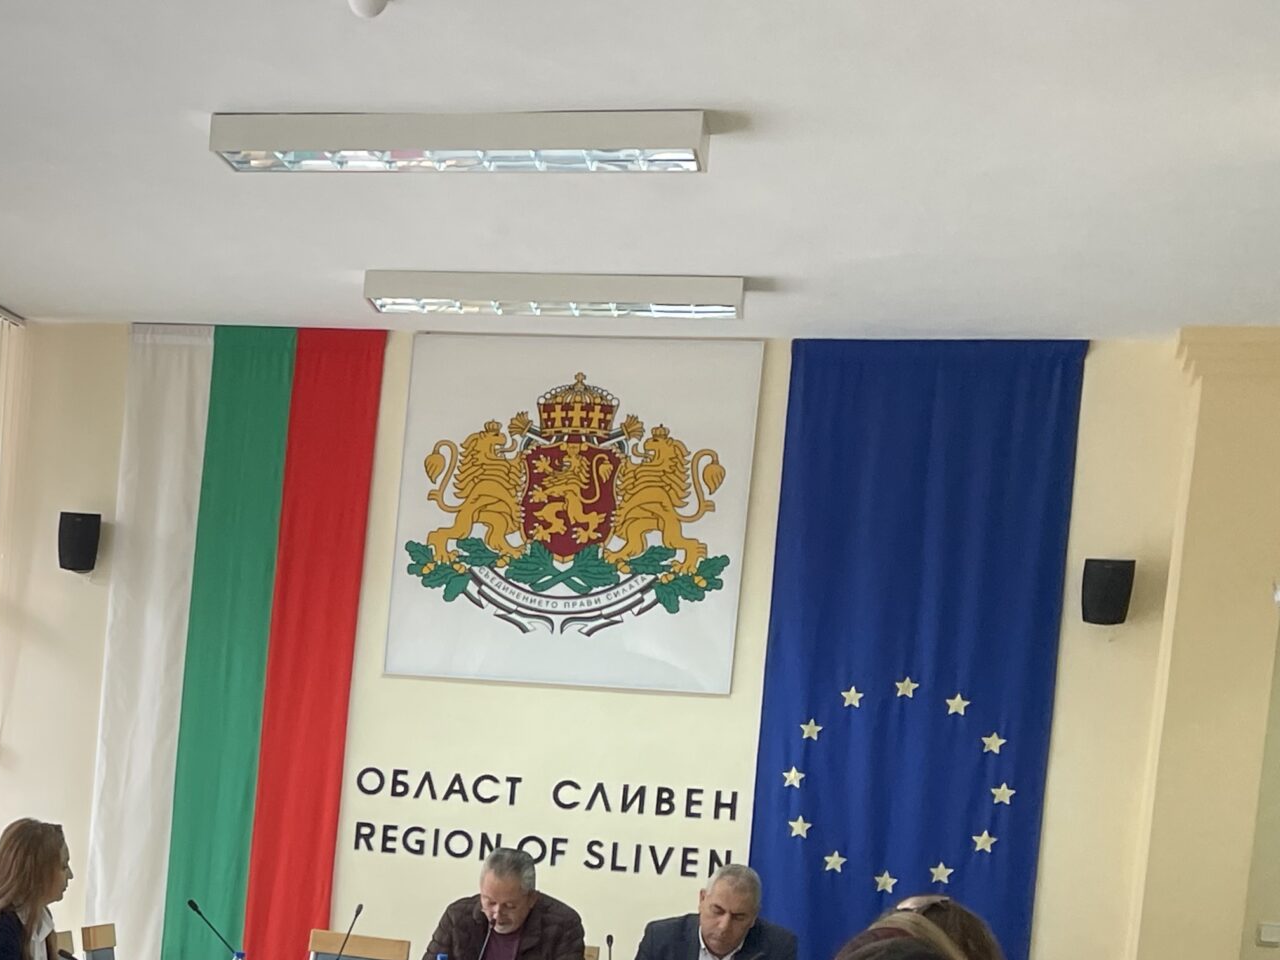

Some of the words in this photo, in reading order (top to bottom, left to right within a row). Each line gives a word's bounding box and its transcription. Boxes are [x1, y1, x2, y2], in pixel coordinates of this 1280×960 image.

[479, 566, 559, 609] СЪЕДИНЕНИЕТО
[563, 597, 602, 609] ПРАВИ
[605, 575, 648, 601] СИЛАТА
[356, 766, 522, 805] ОБЛАСТ
[552, 779, 739, 821] СЛИВЕН
[353, 821, 502, 861] REGION
[517, 835, 569, 867] OF
[583, 840, 732, 878] SLIVEN
